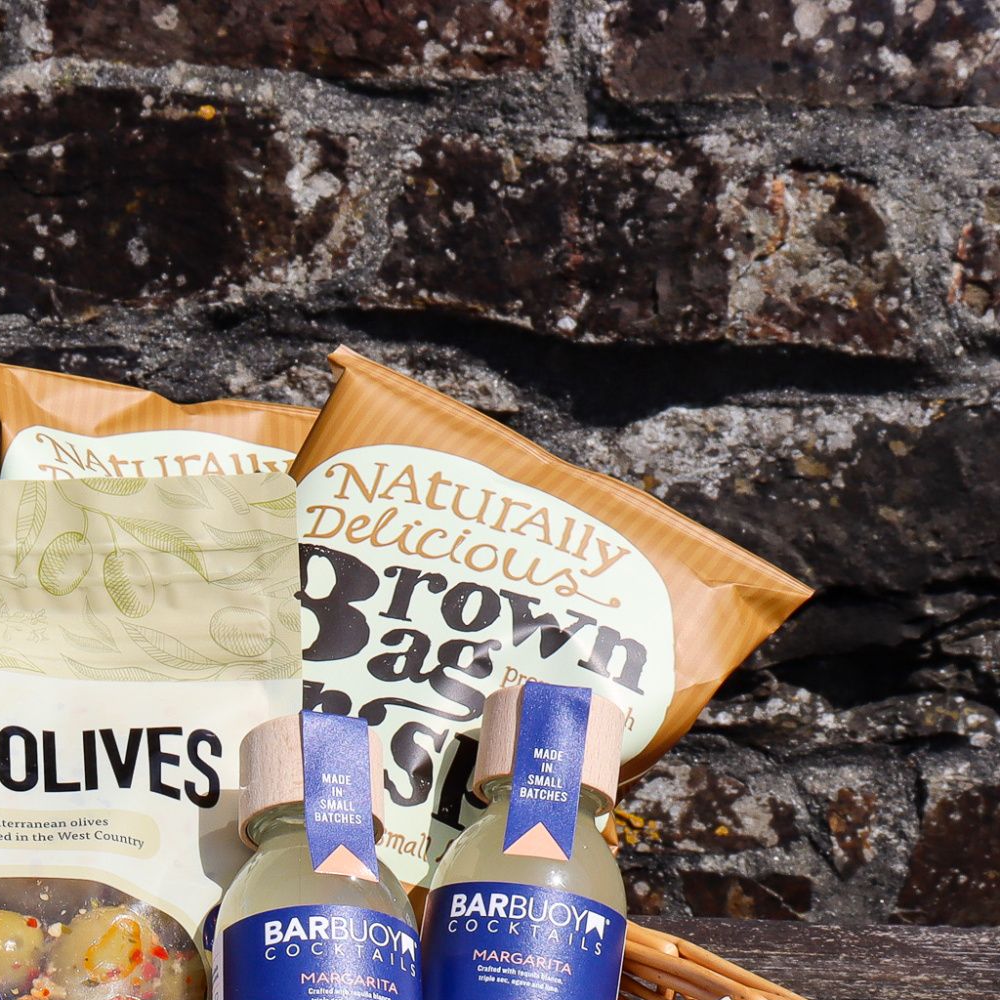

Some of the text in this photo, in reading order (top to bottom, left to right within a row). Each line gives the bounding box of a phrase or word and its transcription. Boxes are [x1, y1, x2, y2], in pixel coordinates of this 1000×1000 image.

[302, 504, 622, 608] Delicious
[295, 543, 647, 695] Brown
[359, 628, 501, 726] Bag
[534, 748, 565, 762] MADE
[540, 762, 553, 773] IN
[321, 773, 351, 786] MADE
[527, 774, 563, 789] SMALL
[331, 787, 343, 797] IN
[519, 787, 568, 803] BATCHES
[319, 799, 355, 811] SMALL
[70, 817, 109, 827] olives
[314, 812, 362, 825] BATCHES
[15, 832, 29, 842] in
[32, 832, 54, 842] the
[57, 831, 90, 841] West
[94, 830, 145, 850] Country
[450, 892, 588, 932] BARBUOY
[264, 915, 400, 952] BARBUOY
[447, 919, 603, 956] COCKTAILS
[264, 941, 417, 977] COCKTAILS
[472, 949, 572, 976] MARGARITA
[477, 964, 501, 973] Crafted
[501, 967, 516, 975] with
[301, 972, 398, 995] MARGARITA
[308, 987, 334, 995] Crafted
